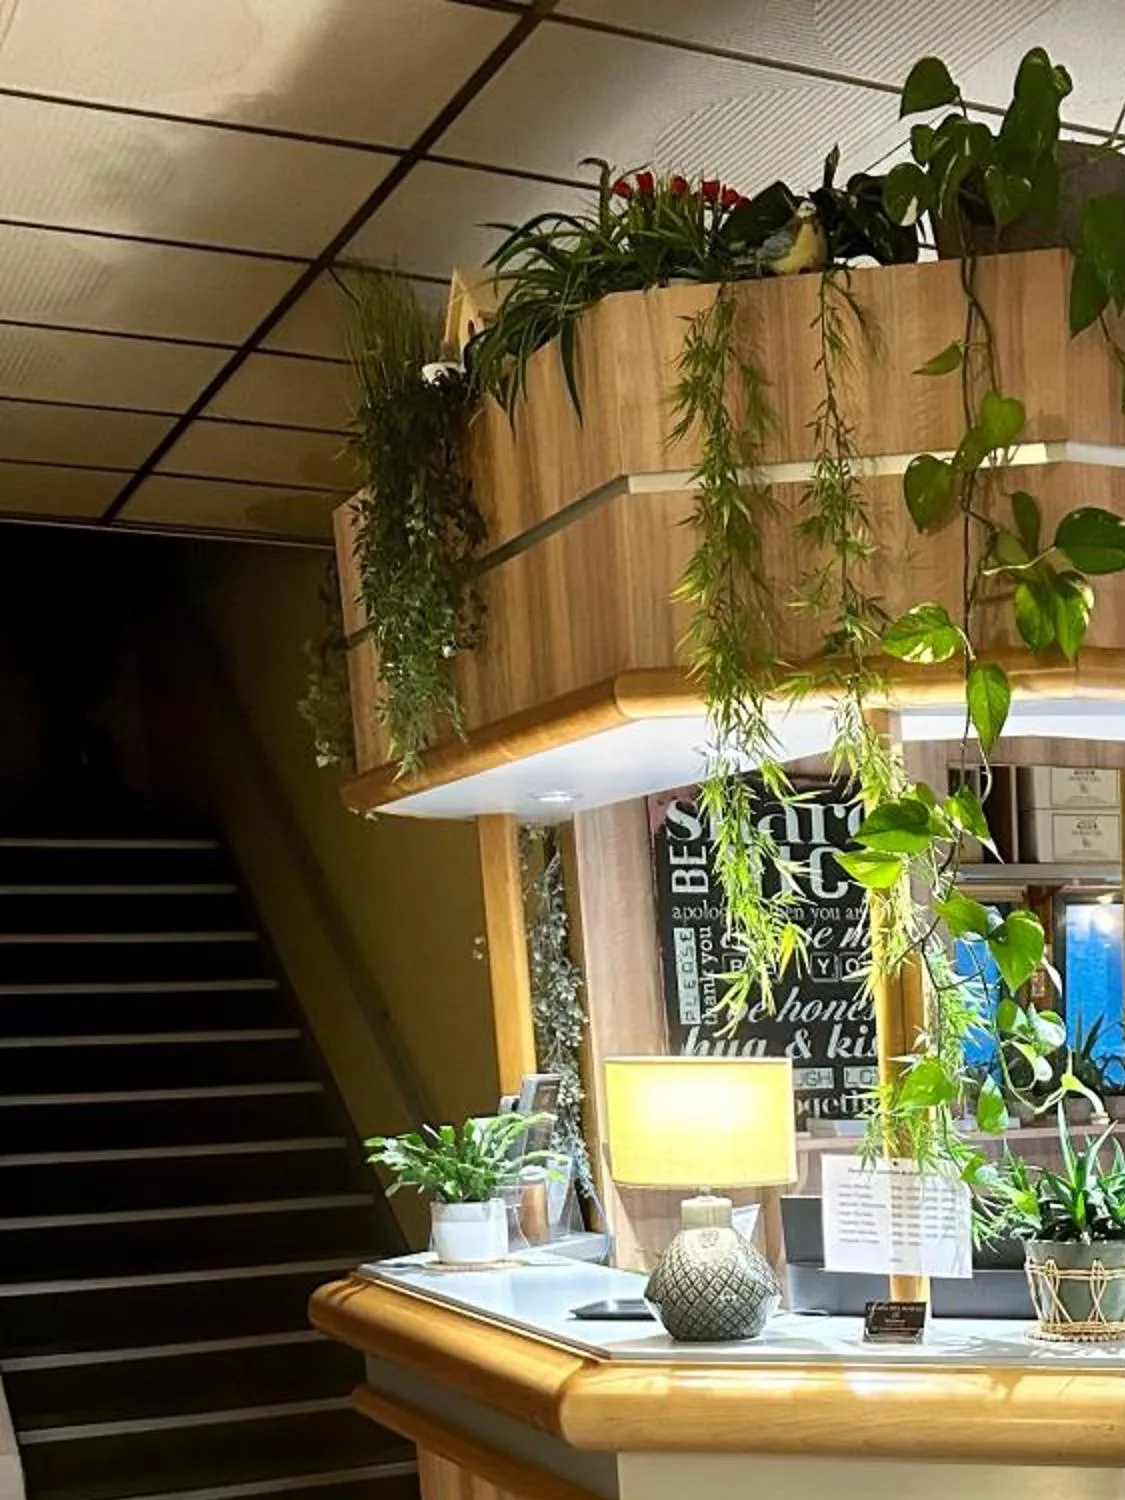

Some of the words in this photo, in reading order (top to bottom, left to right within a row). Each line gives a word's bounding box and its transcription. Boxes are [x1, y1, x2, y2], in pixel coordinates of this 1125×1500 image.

[669, 846, 710, 893] BE
[811, 906, 841, 926] you
[699, 926, 719, 965] you
[785, 1028, 811, 1059] &
